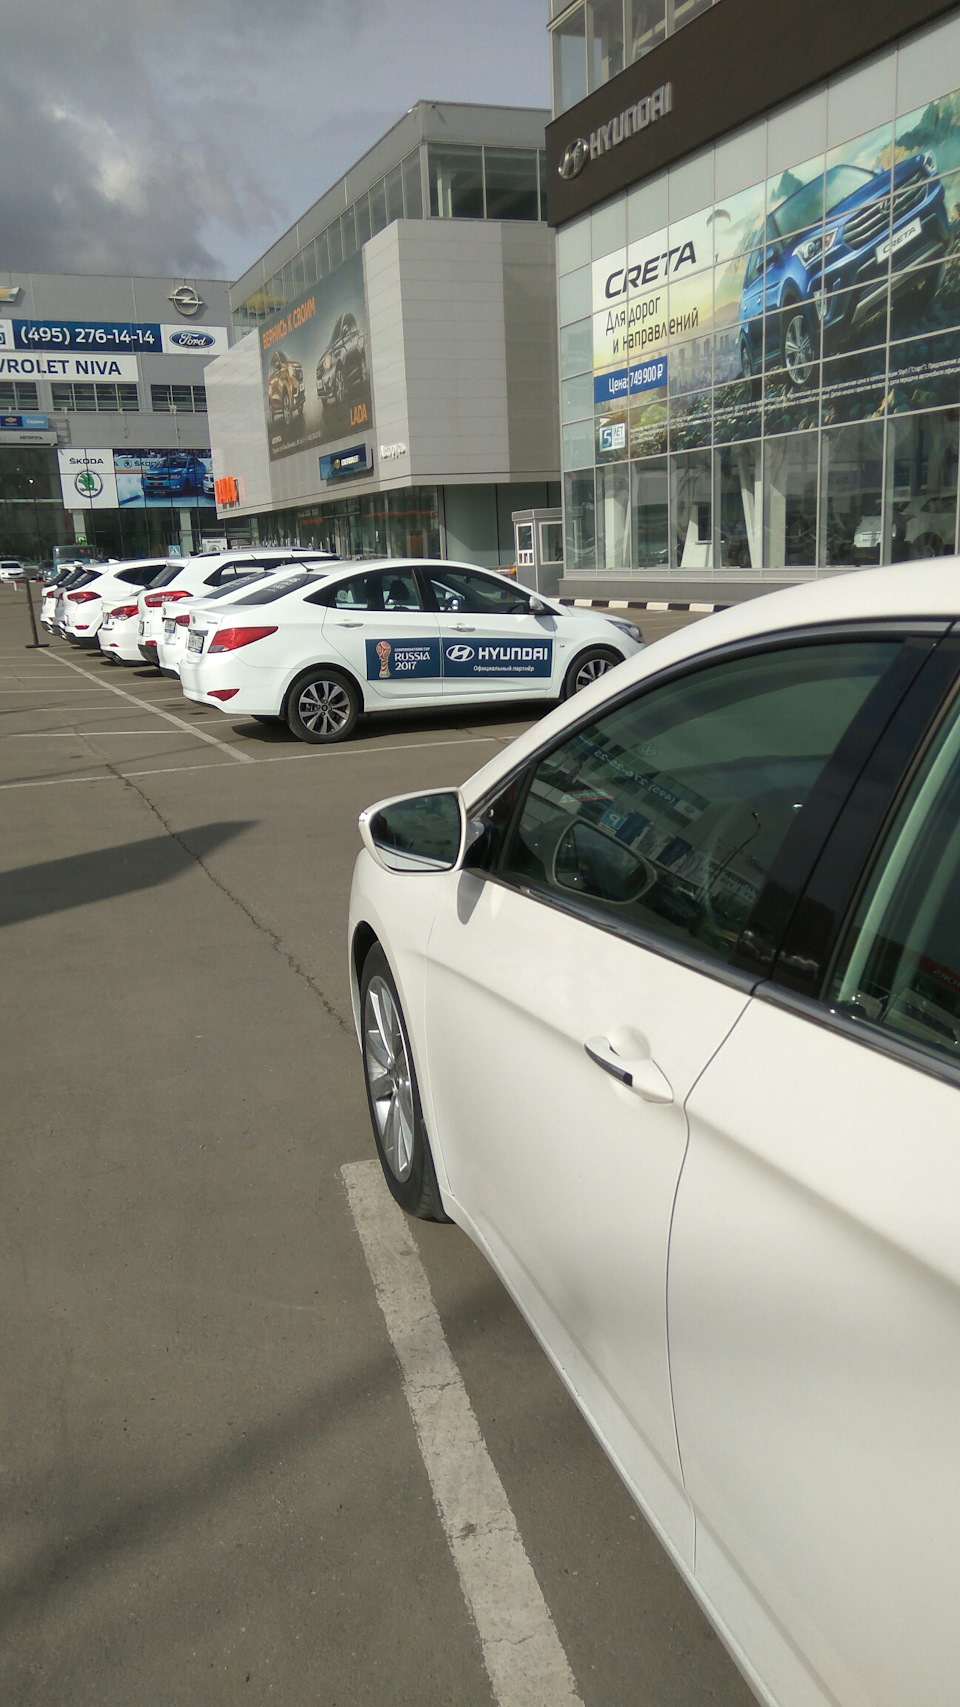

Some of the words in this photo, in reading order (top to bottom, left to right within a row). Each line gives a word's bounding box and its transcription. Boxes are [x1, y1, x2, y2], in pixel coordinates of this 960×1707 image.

[589, 81, 672, 161] HYUNDAI
[883, 226, 916, 254] CRETA
[605, 240, 697, 299] CRETA
[606, 310, 626, 336] Для
[628, 296, 661, 328] дорог
[21, 326, 70, 345] (495)
[75, 328, 155, 344] 276-14-14
[178, 331, 206, 347] Ford
[612, 338, 619, 354] и
[623, 307, 699, 350] направлений
[75, 360, 122, 375] NIVA
[630, 369, 643, 388] 749
[643, 365, 657, 383] 900
[350, 402, 368, 426] LADA
[602, 429, 613, 448] 5
[69, 457, 105, 465] ŠKODA
[394, 652, 431, 661] RUSSIA
[478, 647, 548, 660] HYUNDAI
[394, 662, 417, 671] 2017
